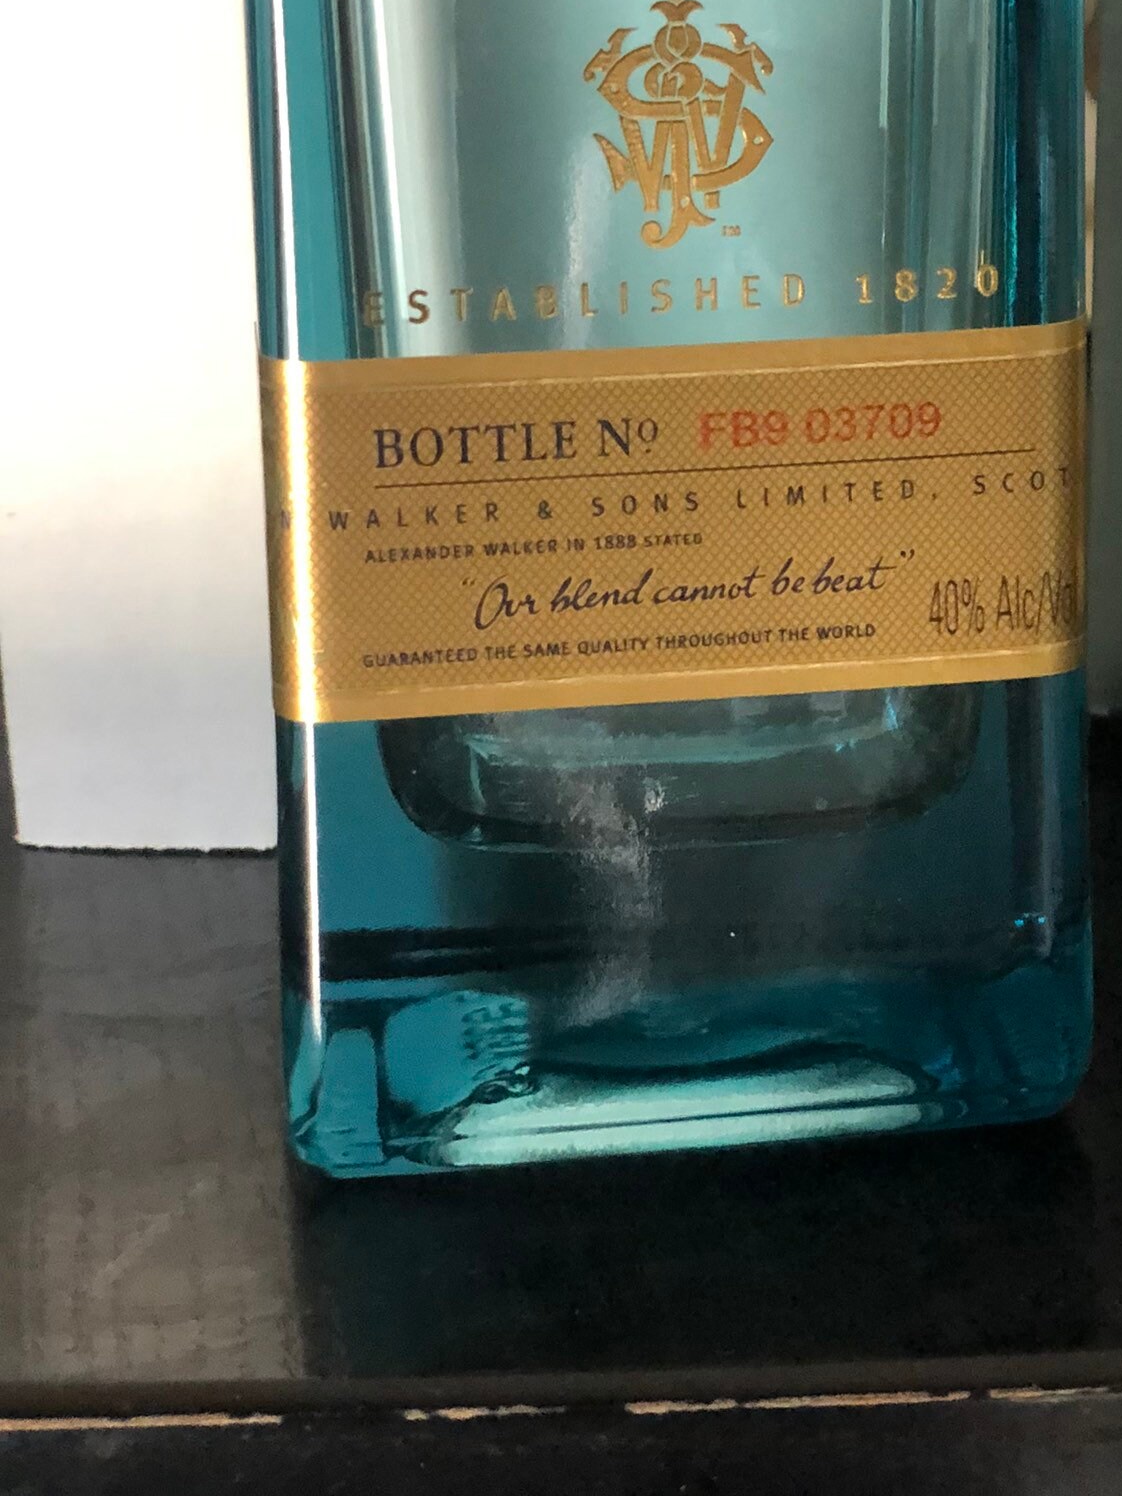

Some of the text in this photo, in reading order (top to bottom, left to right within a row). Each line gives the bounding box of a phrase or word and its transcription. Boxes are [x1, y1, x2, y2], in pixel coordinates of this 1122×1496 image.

[363, 263, 999, 328] ESTABLISHED 1820
[373, 419, 578, 469] BOTTLE
[698, 409, 790, 451] FB9
[804, 401, 943, 444] 03709
[328, 502, 499, 531] WALKER
[537, 500, 553, 520] &
[591, 491, 699, 517] SONS
[364, 532, 703, 564] ALEXANDER WALKER IN 1888 STATED
[550, 567, 654, 612] blend
[653, 565, 766, 603] cannot
[771, 556, 806, 596] be
[928, 575, 986, 636] 40%
[362, 623, 876, 669] GUARANTEED THE SAME QUALITY THROUGHOUT THE WORLD
